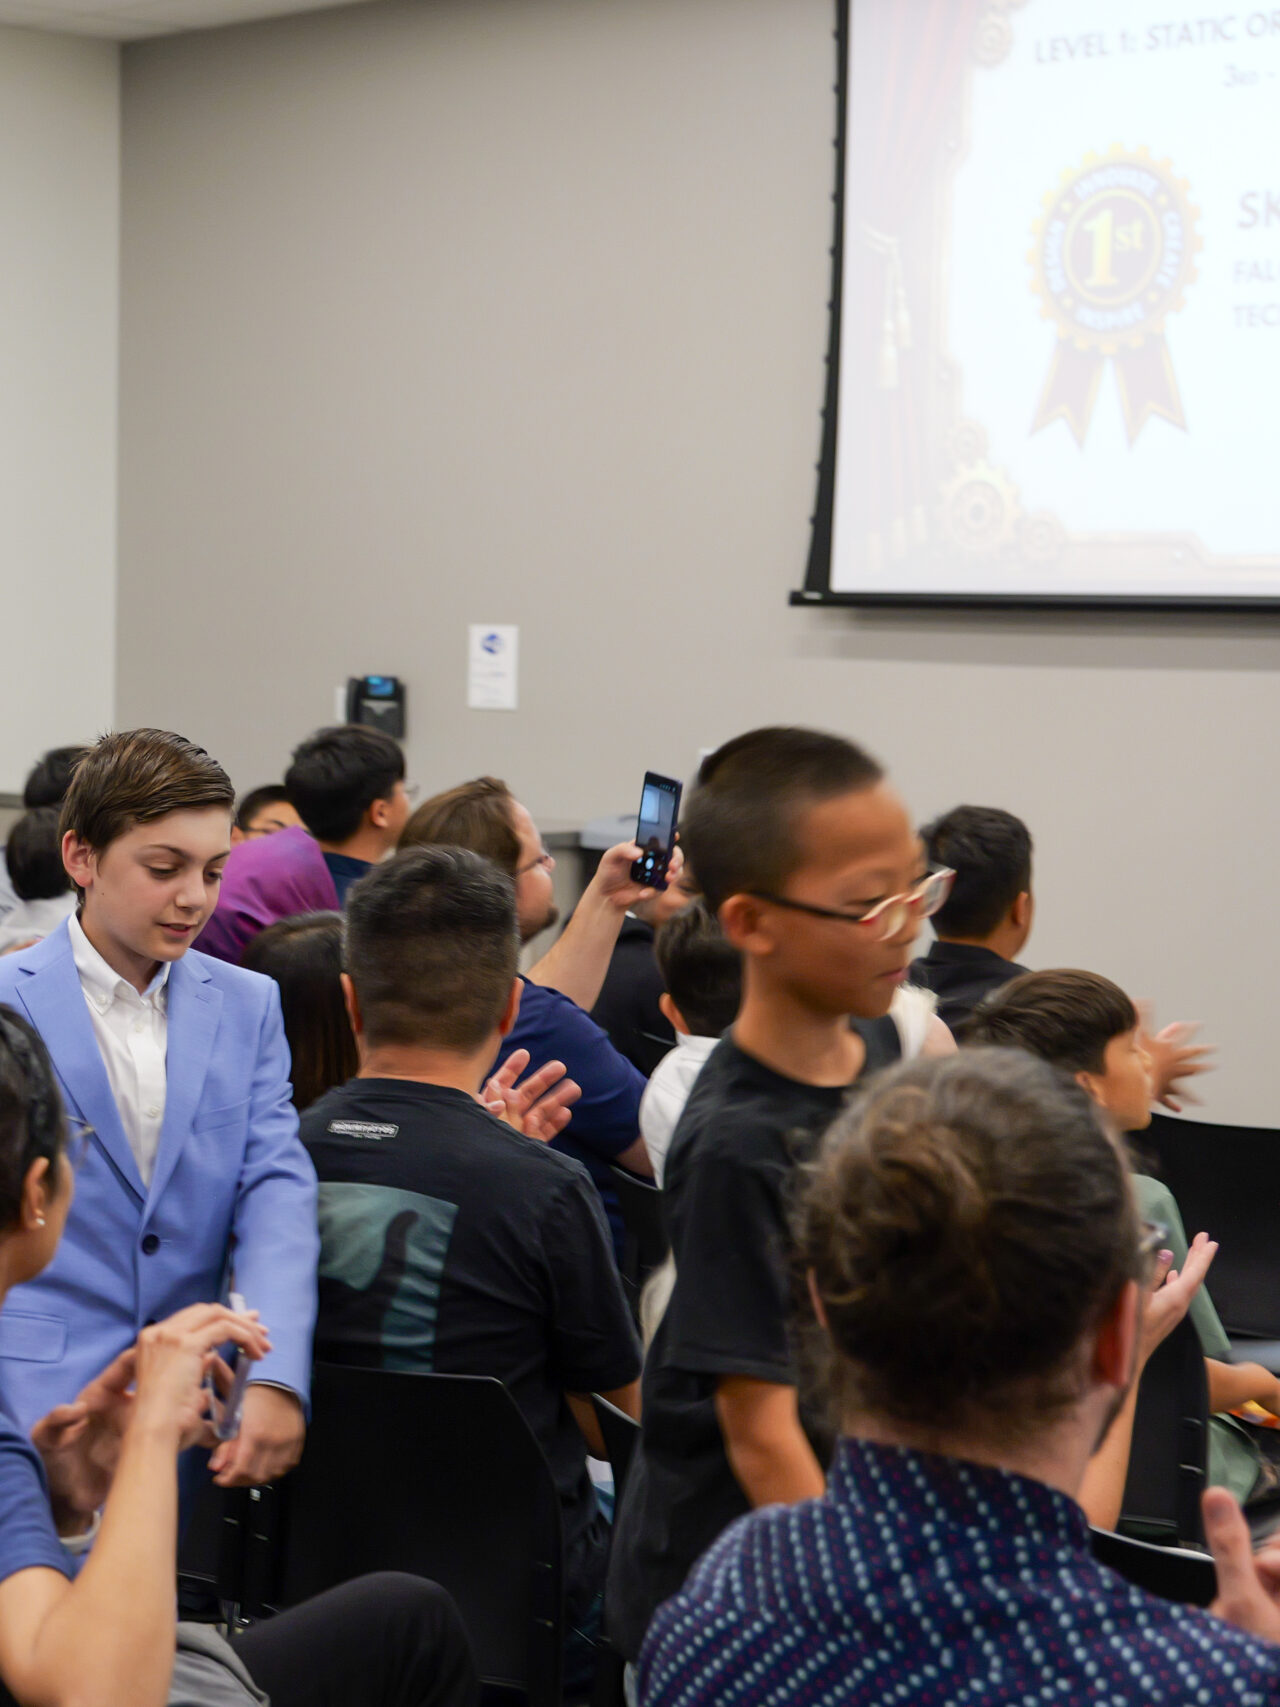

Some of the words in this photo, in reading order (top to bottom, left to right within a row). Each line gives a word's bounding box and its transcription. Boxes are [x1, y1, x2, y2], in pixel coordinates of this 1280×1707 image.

[1035, 31, 1111, 65] LEVEL
[1145, 14, 1239, 52] STATIC
[1082, 207, 1145, 287] 1st
